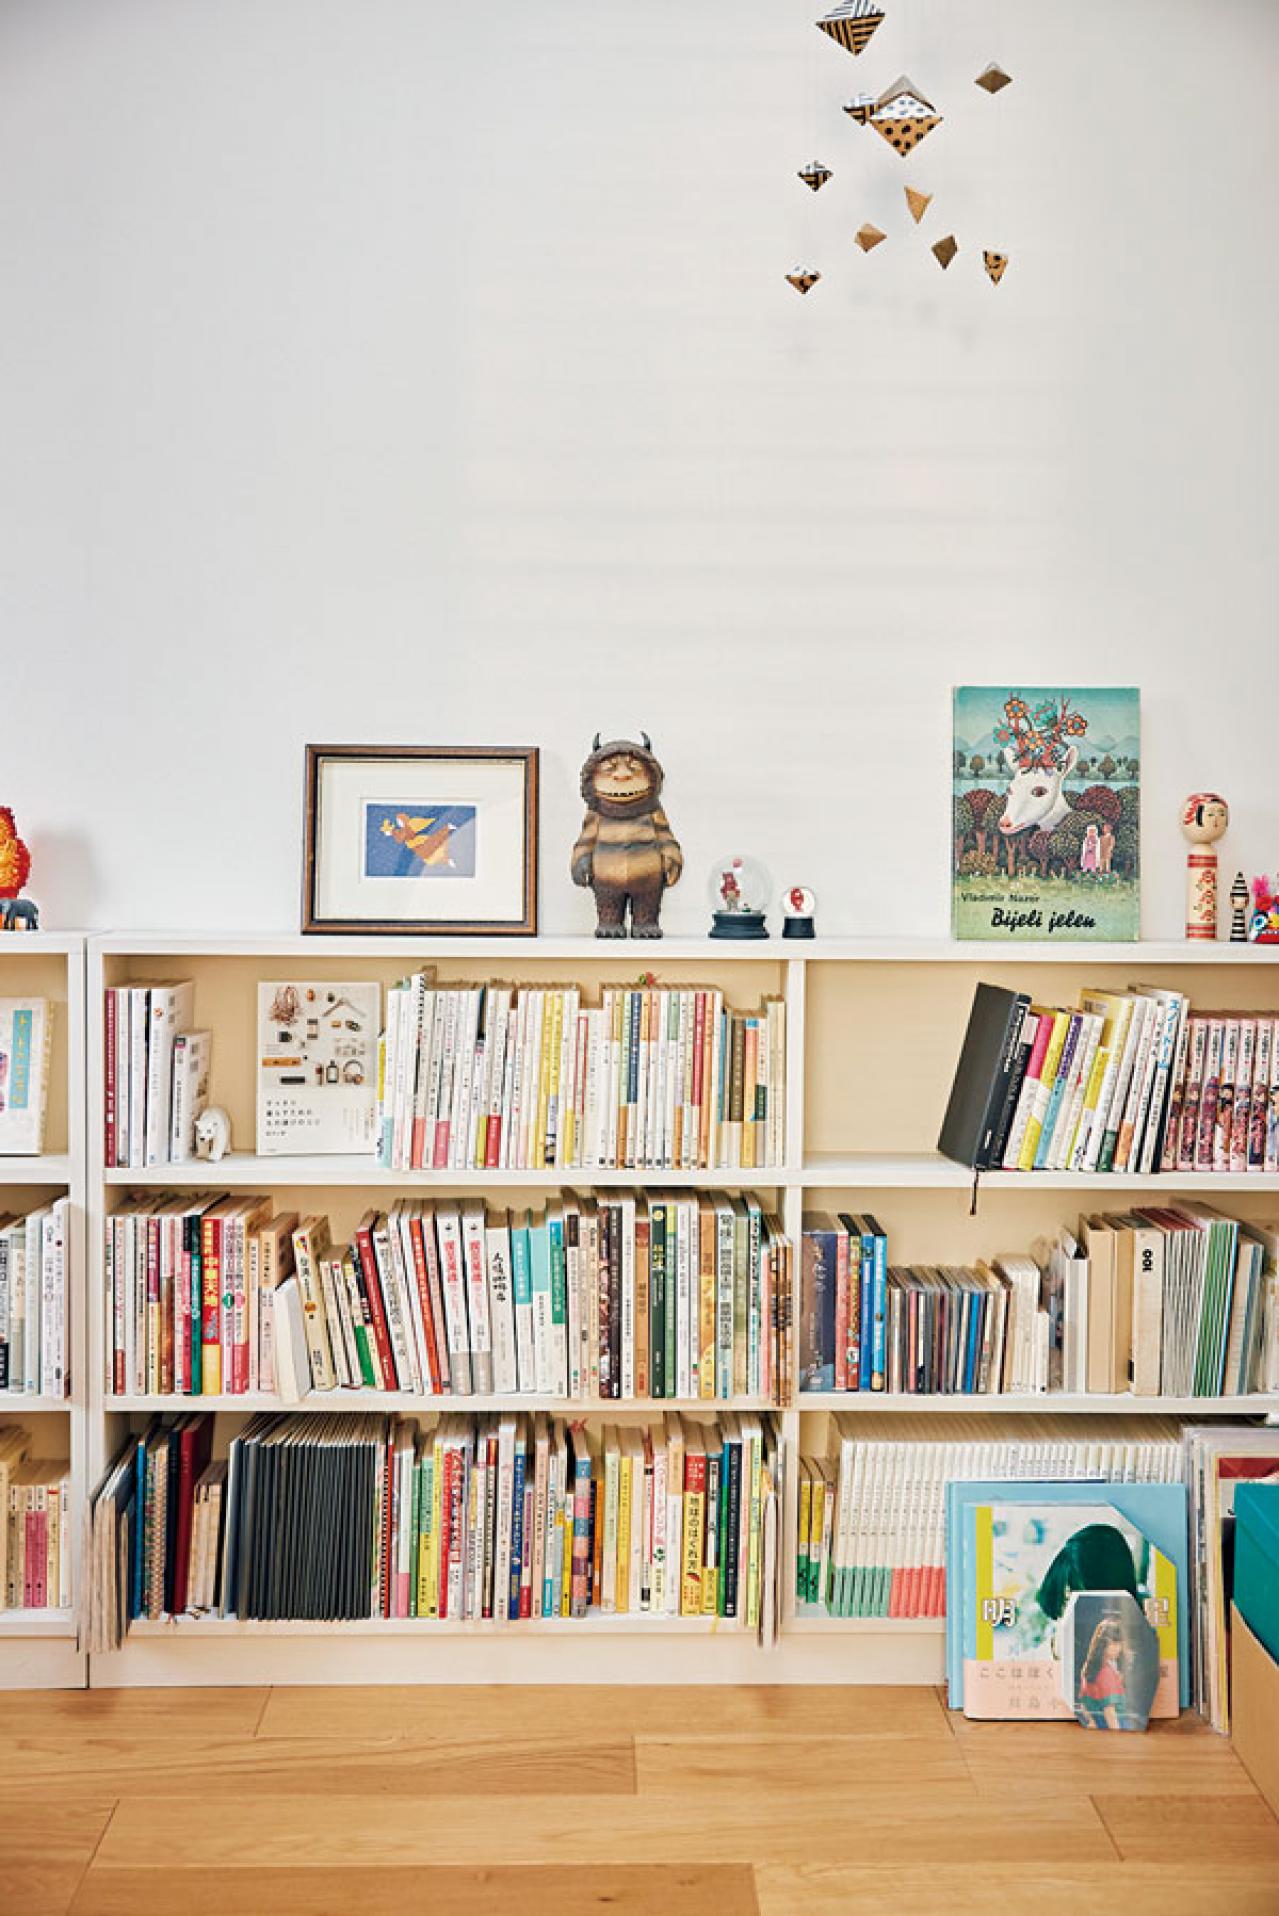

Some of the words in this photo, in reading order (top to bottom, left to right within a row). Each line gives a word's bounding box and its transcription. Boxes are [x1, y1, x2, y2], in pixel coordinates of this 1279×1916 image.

[961, 893, 1004, 903] Vladimir
[991, 908, 1043, 932] Bijeli
[1049, 909, 1095, 933] jelen
